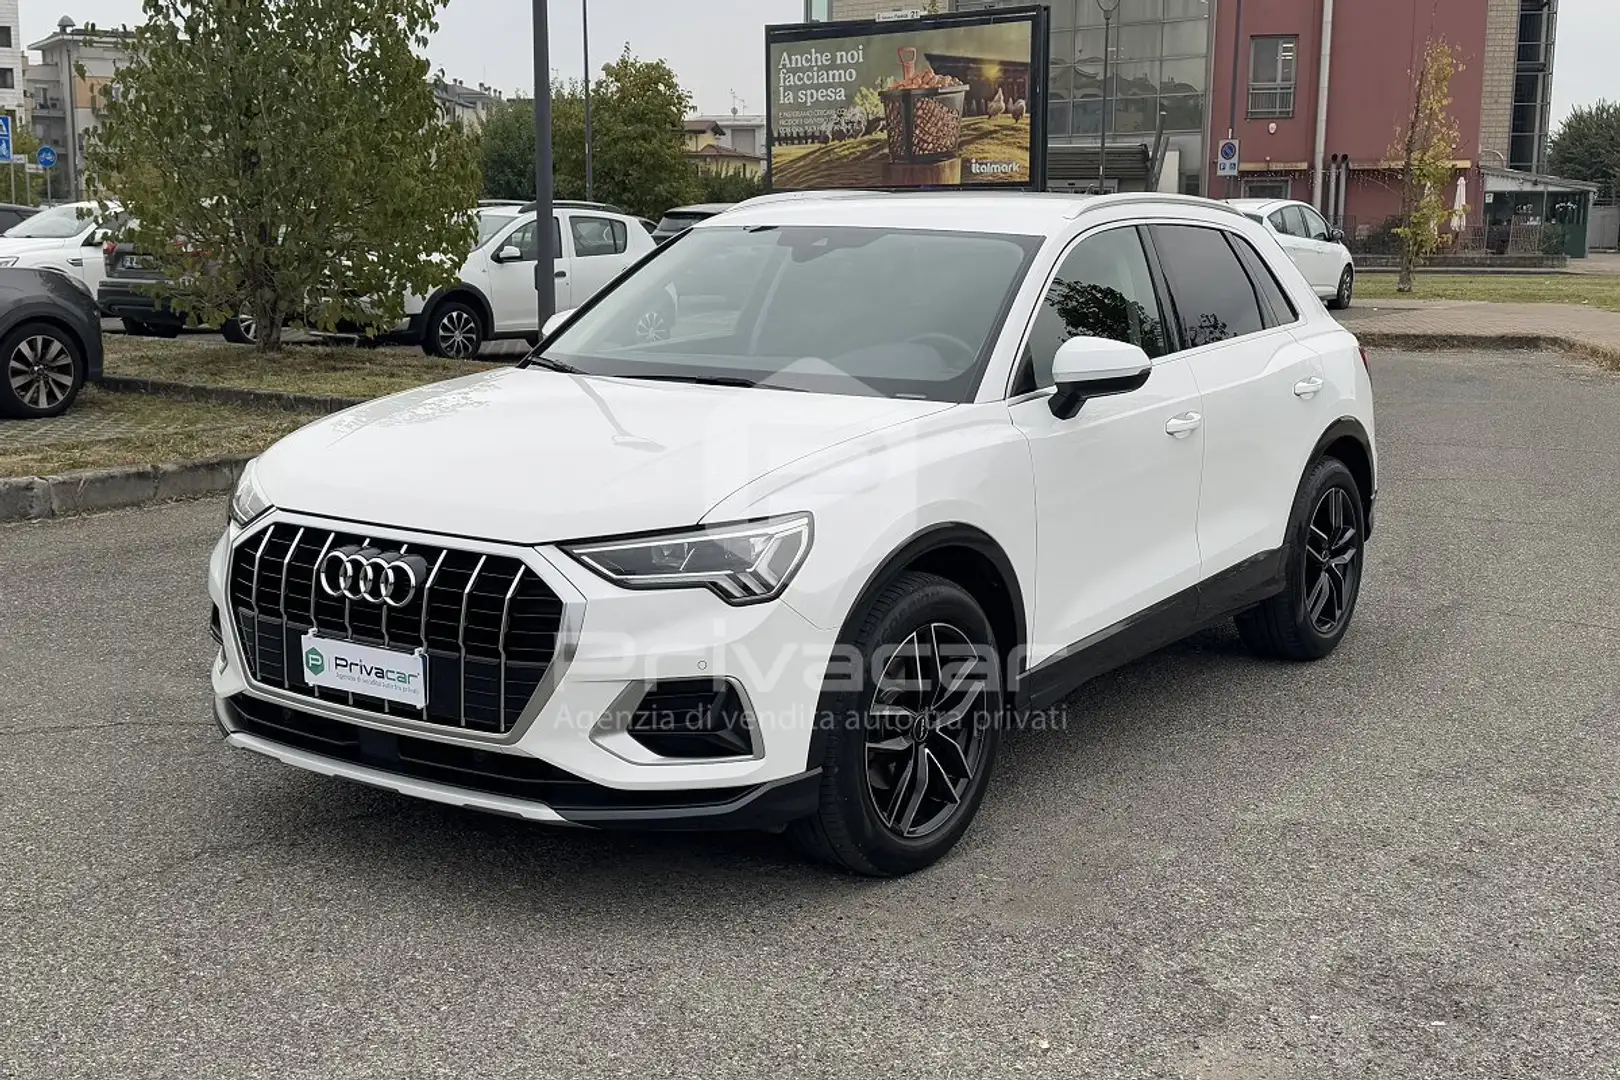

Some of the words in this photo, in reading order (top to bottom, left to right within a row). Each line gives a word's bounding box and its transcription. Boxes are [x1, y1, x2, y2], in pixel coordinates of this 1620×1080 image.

[778, 48, 831, 68] Anche
[836, 45, 864, 64] noi
[779, 67, 856, 86] facciamo
[779, 87, 794, 103] la
[798, 87, 846, 106] spesa
[971, 158, 1020, 173] italmark
[335, 656, 418, 684] Privacar
